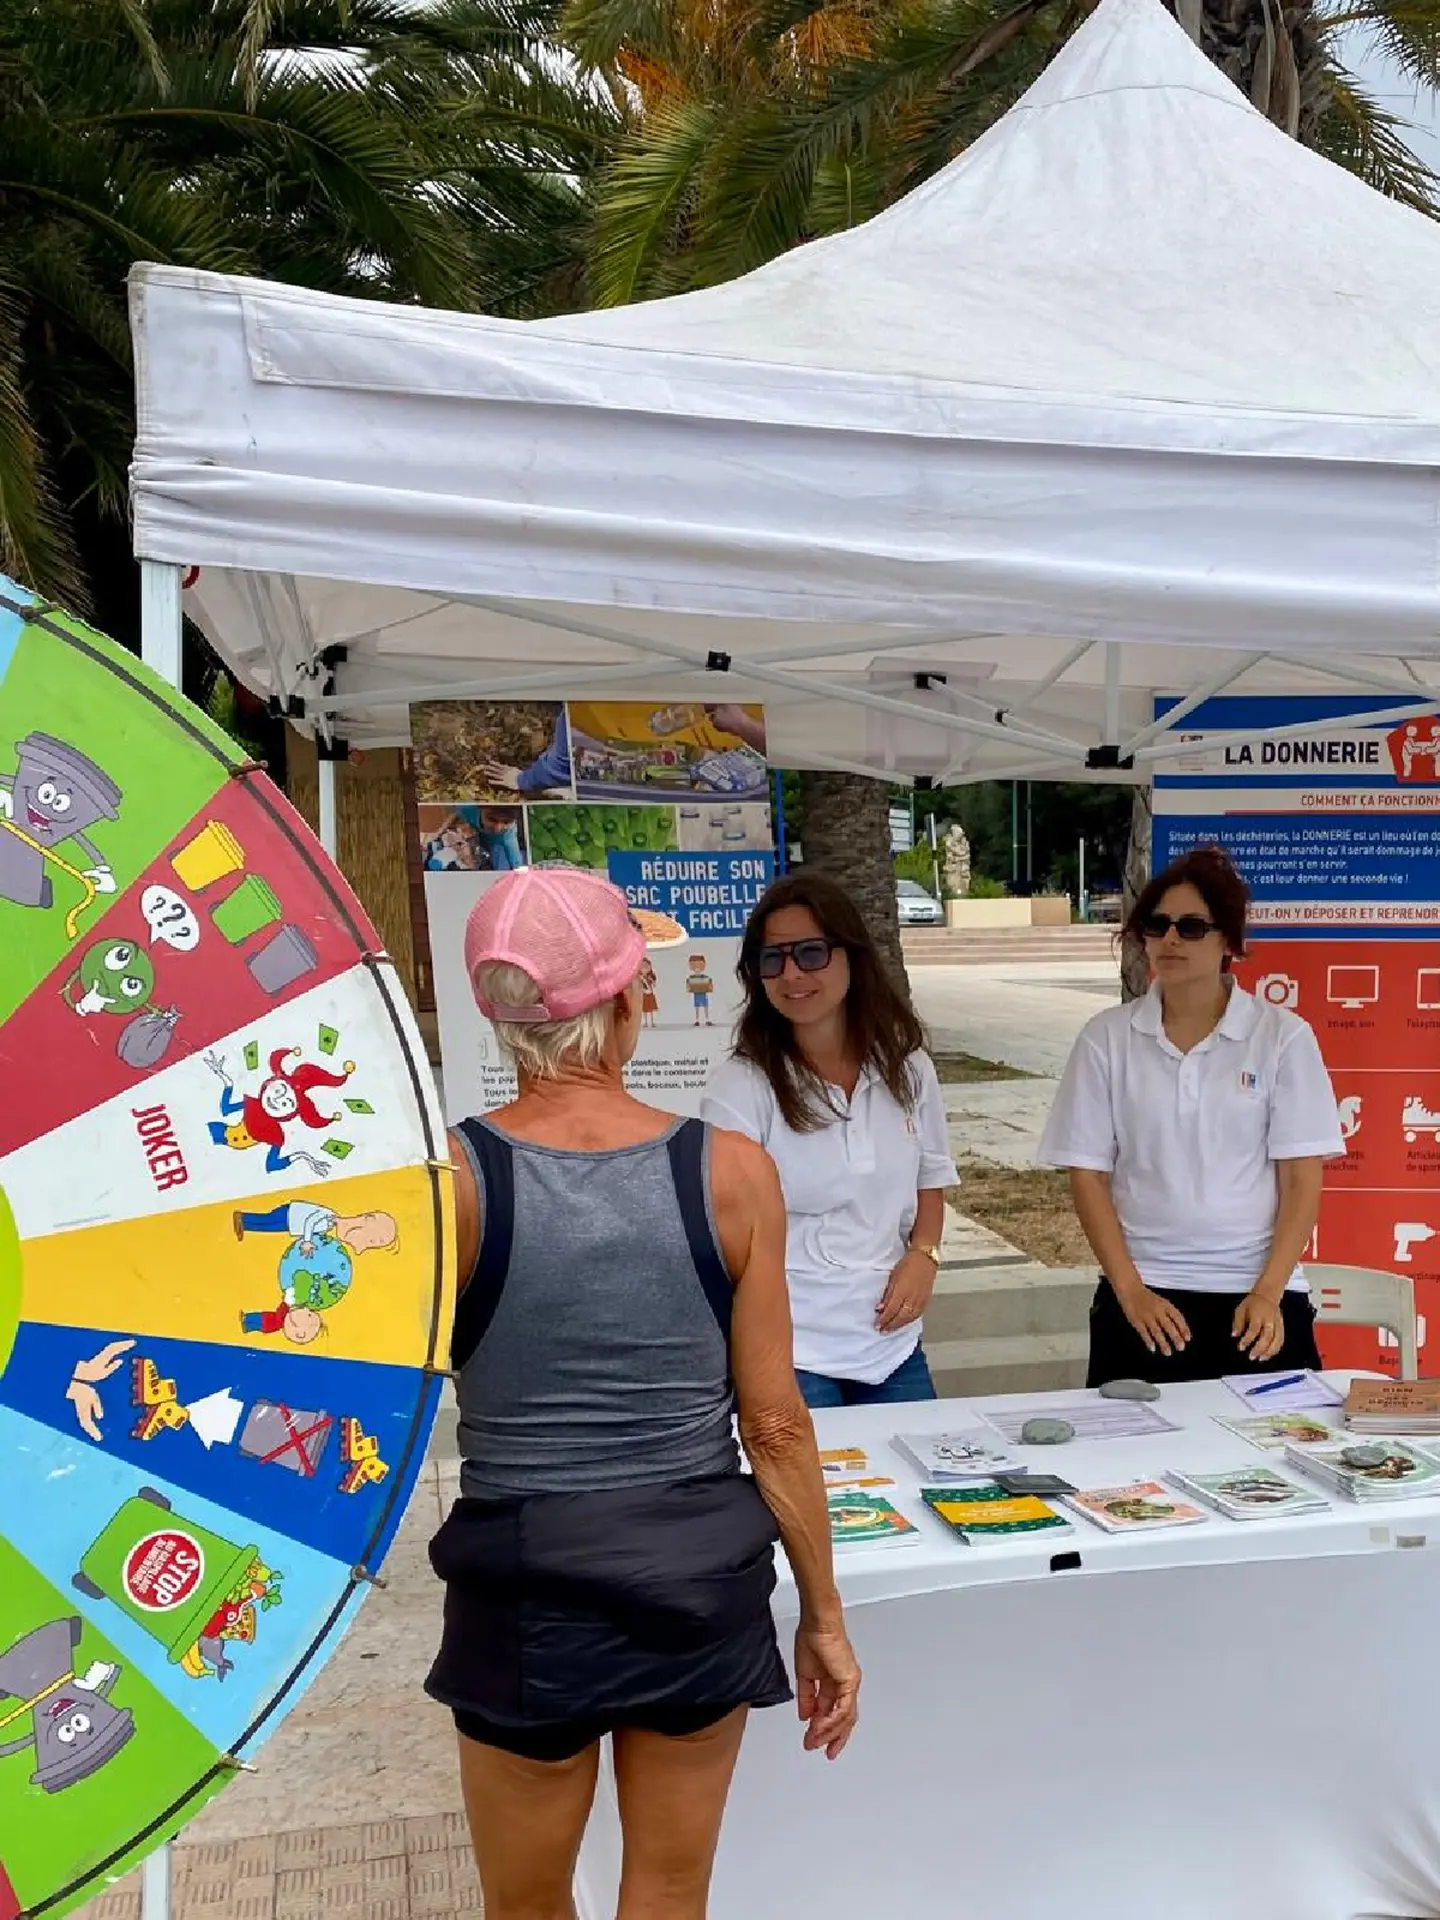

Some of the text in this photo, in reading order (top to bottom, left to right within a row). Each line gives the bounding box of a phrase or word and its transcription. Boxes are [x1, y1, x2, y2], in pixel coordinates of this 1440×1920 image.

[1224, 744, 1254, 764] LA
[1261, 741, 1379, 764] DONNERIE
[1301, 794, 1356, 806] COMMENT
[1198, 831, 1219, 841] dans
[1221, 831, 1234, 841] les
[1292, 830, 1300, 840] la
[1303, 829, 1351, 840] DONNERIE
[1353, 831, 1368, 840] est
[1369, 831, 1380, 840] un
[1381, 830, 1399, 840] lieu
[1168, 846, 1184, 856] des
[1259, 845, 1277, 855] état
[1279, 846, 1289, 855] de
[1291, 845, 1325, 855] marche
[1347, 845, 1374, 855] serait
[1375, 845, 1420, 857] dommage
[1422, 845, 1433, 855] de
[641, 856, 765, 880] RÉDUIRE SON
[1256, 860, 1298, 870] pourront
[1299, 859, 1318, 869] s'en
[1253, 874, 1274, 884] c'est
[1275, 874, 1295, 883] leur
[1297, 873, 1328, 883] donner
[1331, 874, 1348, 883] une
[1350, 873, 1388, 883] seconde
[1389, 873, 1403, 883] vie
[626, 884, 766, 904] SAC POUBELLE
[1247, 907, 1291, 919] EUT-ON
[1294, 907, 1301, 919] Y
[1304, 903, 1356, 919] DÉPOSER
[1360, 907, 1374, 919] ET
[132, 1103, 188, 1191] JOKER
[152, 1550, 199, 1605] STOP
